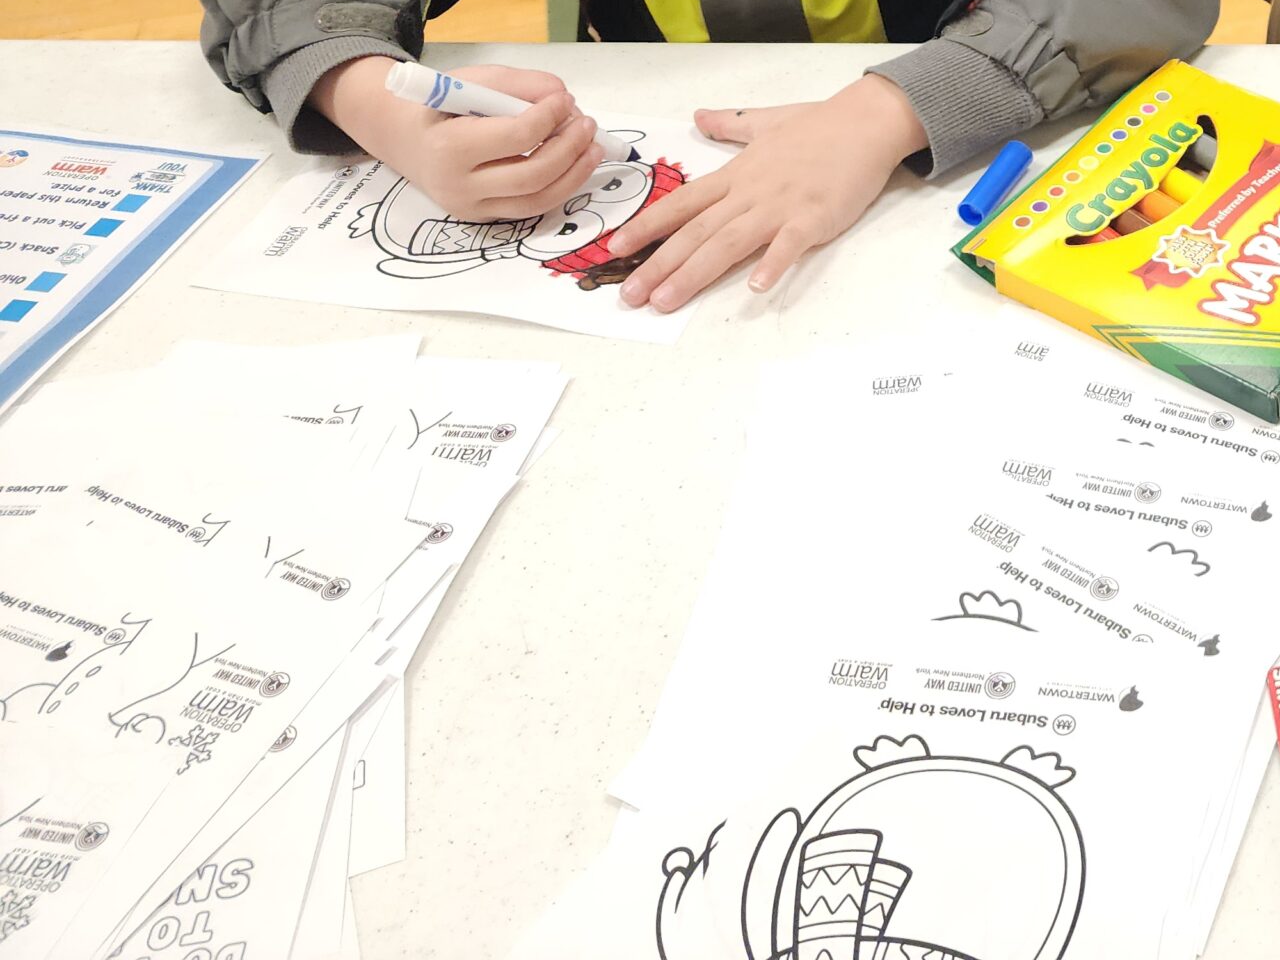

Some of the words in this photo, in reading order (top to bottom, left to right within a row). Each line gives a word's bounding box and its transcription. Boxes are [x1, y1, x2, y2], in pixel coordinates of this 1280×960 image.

[42, 170, 101, 181] OPERATION
[51, 162, 109, 176] warm
[1066, 121, 1199, 233] Crayola
[99, 188, 122, 198] for
[131, 182, 173, 194] THANK
[37, 194, 62, 204] this
[65, 196, 110, 209] Return
[1207, 192, 1247, 229] Preferred
[1242, 184, 1258, 201] by
[32, 213, 55, 226] out
[58, 219, 87, 230] Pick
[20, 242, 60, 255] Snack
[872, 376, 922, 390] warm
[1083, 392, 1130, 408] OPERATION
[1086, 382, 1133, 403] warm
[1160, 406, 1178, 418] WAY
[1178, 410, 1207, 424] UNITED
[1122, 414, 1151, 430] Help
[1154, 422, 1168, 433] to
[441, 429, 460, 439] WAY
[460, 429, 489, 440] UNITED
[1169, 425, 1208, 444] Loves
[1210, 436, 1259, 457] Subaru
[1002, 461, 1053, 481] warm
[7, 485, 43, 493] Loves
[87, 485, 112, 503] Help
[1081, 481, 1101, 492] WAY
[1102, 485, 1132, 498] UNITED
[124, 501, 151, 518] Loves
[1077, 500, 1091, 512] to
[1180, 495, 1249, 514] WATERTOWN
[1093, 504, 1135, 521] Loves
[150, 511, 189, 534] Subaru
[1137, 511, 1189, 530] Subaru
[973, 514, 1021, 548] warm
[968, 525, 1014, 553] OPERATION
[999, 560, 1030, 583] Help
[1041, 558, 1060, 573] WAY
[280, 570, 297, 583] WAY
[296, 575, 324, 592] UNITED
[1029, 576, 1044, 591] to
[1059, 566, 1091, 589] UNITED
[18, 600, 31, 612] to
[1044, 585, 1083, 613] Loves
[30, 603, 66, 623] Loves
[63, 614, 107, 637] Subaru
[1084, 606, 1132, 639] Subaru
[1133, 603, 1198, 641] WATERTOWN
[212, 668, 231, 682] WAY
[831, 662, 889, 681] warm
[915, 667, 932, 675] York
[933, 669, 950, 677] New
[951, 671, 985, 681] Northern
[230, 673, 261, 690] UNITED
[828, 676, 887, 690] OPERATION
[924, 678, 946, 689] WAY
[947, 680, 982, 693] UNITED
[1037, 687, 1115, 703] WATERTOWN
[189, 690, 255, 724] warm
[880, 698, 915, 715] Help
[919, 703, 936, 715] to
[939, 705, 987, 722] Loves
[989, 711, 1048, 728] Subaru
[18, 827, 41, 840] WAY
[41, 830, 76, 845] UNITED
[147, 910, 213, 951] TO
